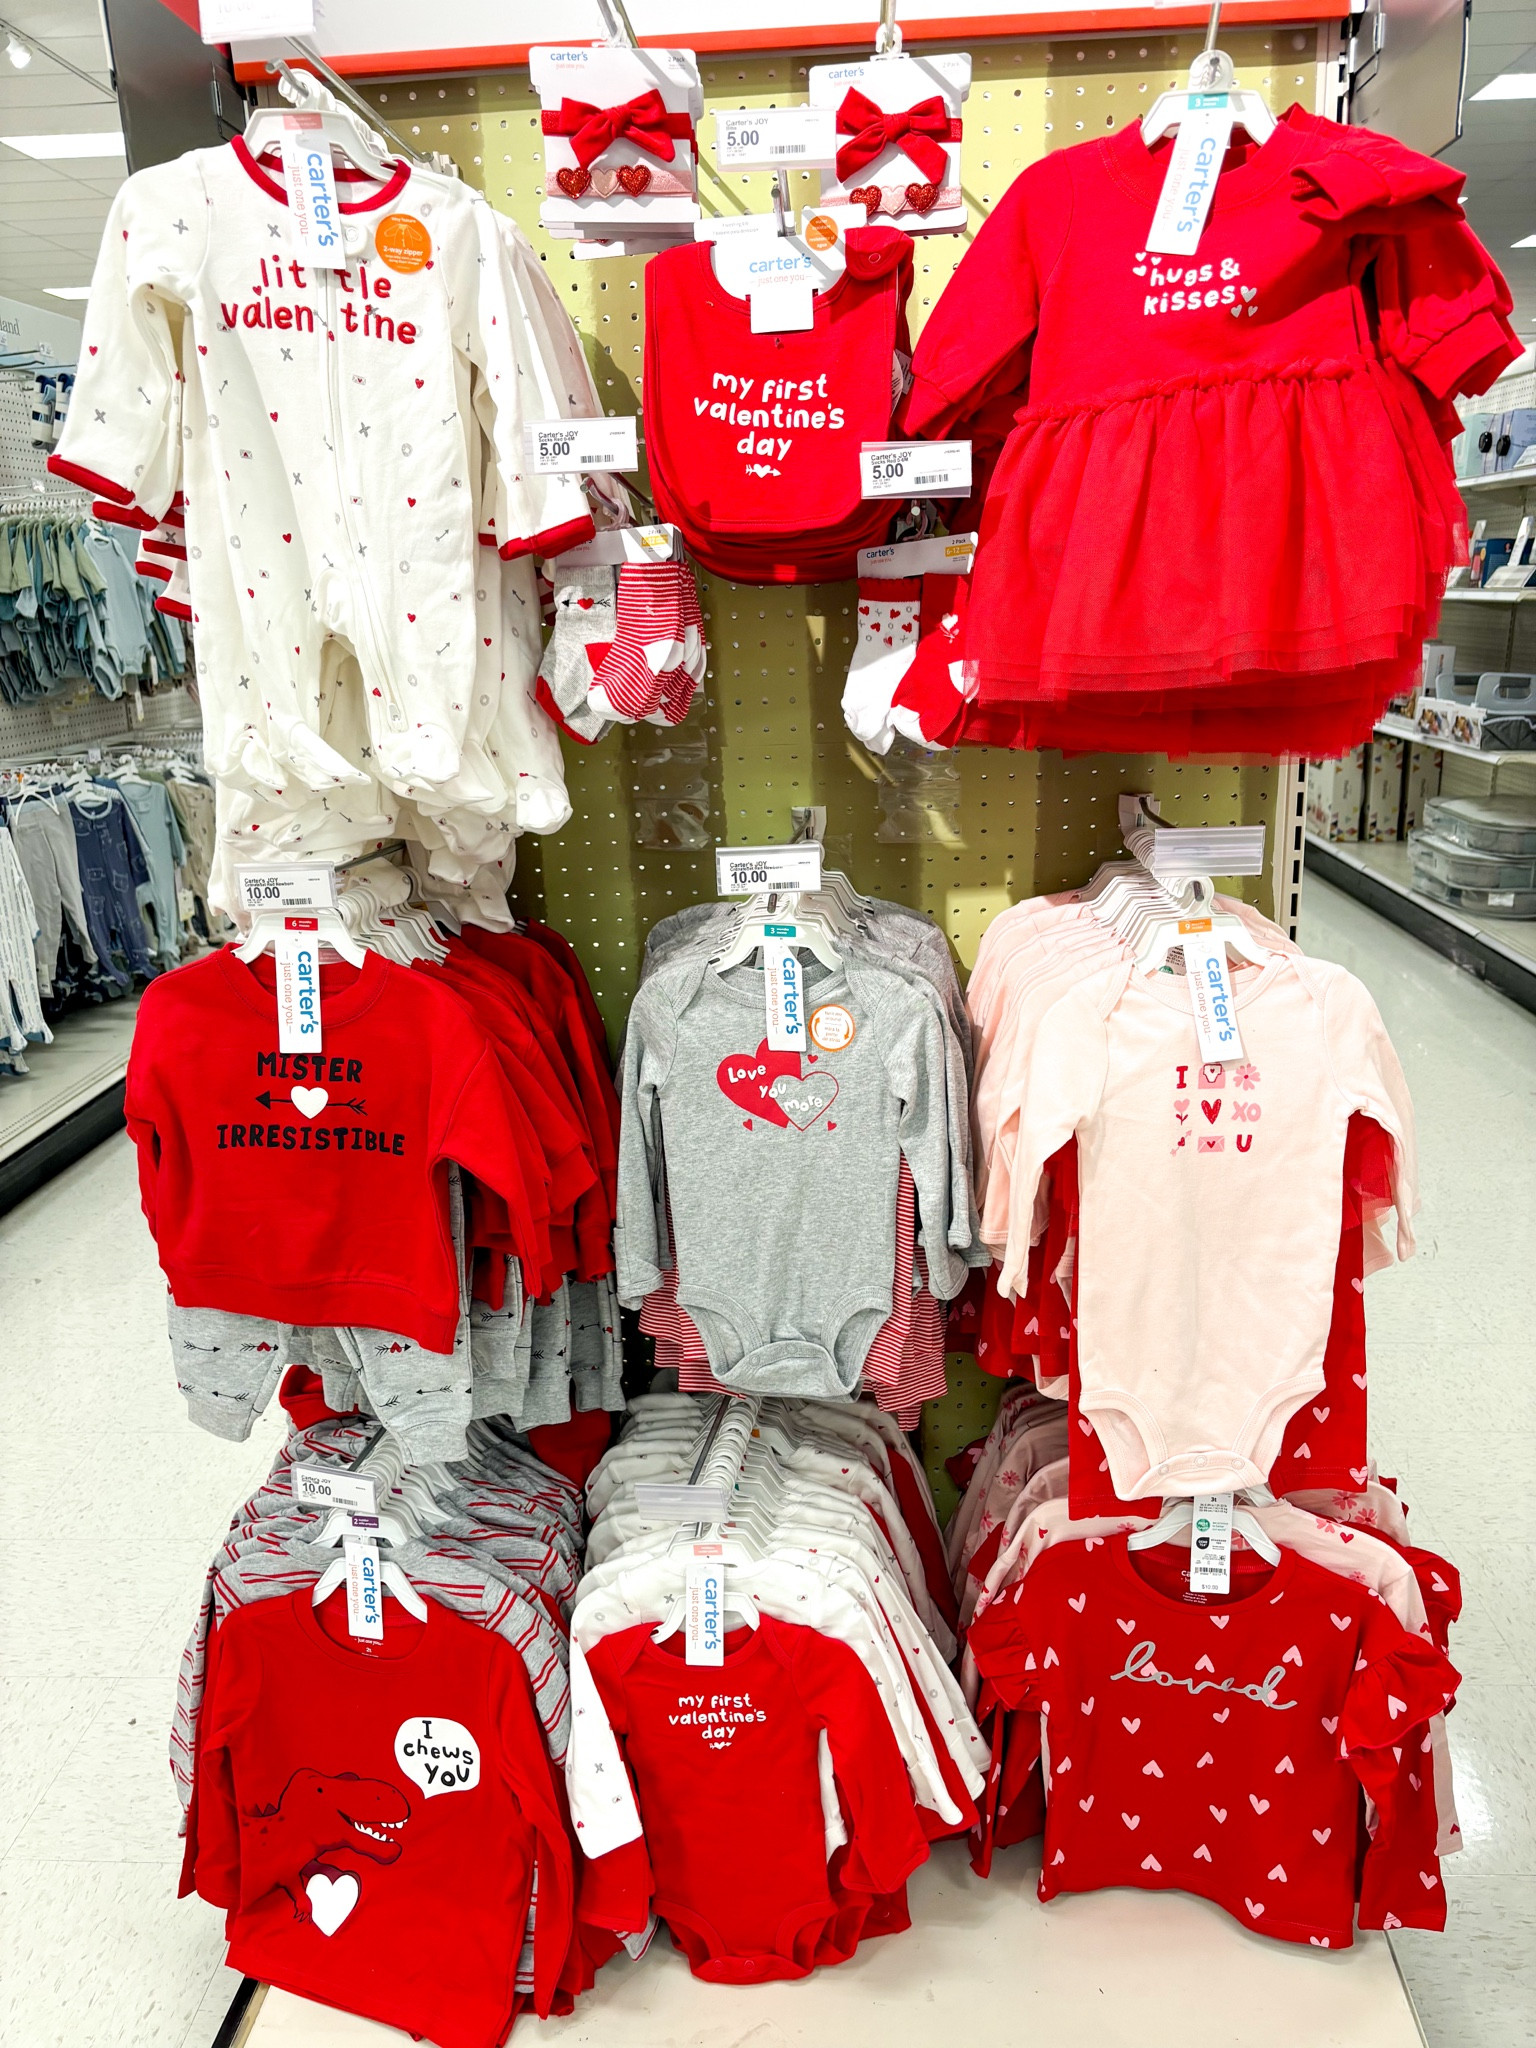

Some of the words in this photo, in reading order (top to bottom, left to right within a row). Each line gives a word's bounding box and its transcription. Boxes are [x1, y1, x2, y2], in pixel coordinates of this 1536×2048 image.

[550, 51, 588, 62] carter's
[828, 67, 865, 79] carter's
[726, 119, 753, 127] Carter's
[727, 130, 760, 146] 5.00
[288, 165, 304, 188] just
[1176, 137, 1216, 232] carter's
[294, 190, 305, 211] one
[307, 153, 339, 246] carter's
[295, 212, 309, 235] you
[404, 248, 423, 257] zipper
[749, 253, 812, 273] carter's
[1150, 264, 1213, 287] hugs
[1219, 257, 1240, 281] &
[757, 276, 773, 287] just
[774, 275, 788, 283] one
[789, 274, 805, 285] you
[1144, 285, 1236, 316] kisses
[712, 372, 755, 400] my
[762, 373, 829, 403] first
[693, 397, 845, 430] valentine's
[538, 431, 564, 439] Carter's
[540, 442, 570, 456] 5.00
[736, 430, 793, 461] day
[871, 452, 897, 461] Carter's
[872, 463, 904, 480] 5.00
[866, 547, 895, 559] carter's
[731, 870, 768, 884] 10.00
[246, 886, 280, 899] 10.00
[280, 962, 293, 982] just
[767, 967, 779, 986] just
[1191, 970, 1203, 990] just
[284, 984, 293, 1003] one
[297, 950, 319, 1034] carter's
[782, 957, 802, 1034] carter's
[1206, 957, 1236, 1042] carter's
[1197, 992, 1207, 1012] one
[282, 1005, 293, 1026] you
[769, 1007, 779, 1026] you
[1198, 1013, 1211, 1034] you
[257, 1051, 363, 1083] MISTER
[727, 1065, 766, 1084] Love
[1176, 1065, 1188, 1089] I
[759, 1083, 786, 1099] you
[783, 1095, 823, 1112] more
[1231, 1100, 1262, 1122] XO
[216, 1124, 405, 1156] IRRESISTIBLE
[1236, 1134, 1252, 1153] U
[302, 1482, 332, 1496] 10.00
[349, 1563, 358, 1580] just
[362, 1557, 380, 1623] carter's
[689, 1586, 701, 1604] just
[350, 1597, 359, 1615] you
[704, 1577, 721, 1650] carter's
[689, 1624, 698, 1641] you
[1110, 1640, 1298, 1710] loved
[678, 1694, 705, 1708] my
[710, 1693, 752, 1709] first
[668, 1708, 767, 1726] valentine's
[422, 1720, 433, 1739] I
[701, 1725, 736, 1740] day
[403, 1738, 474, 1765] chews
